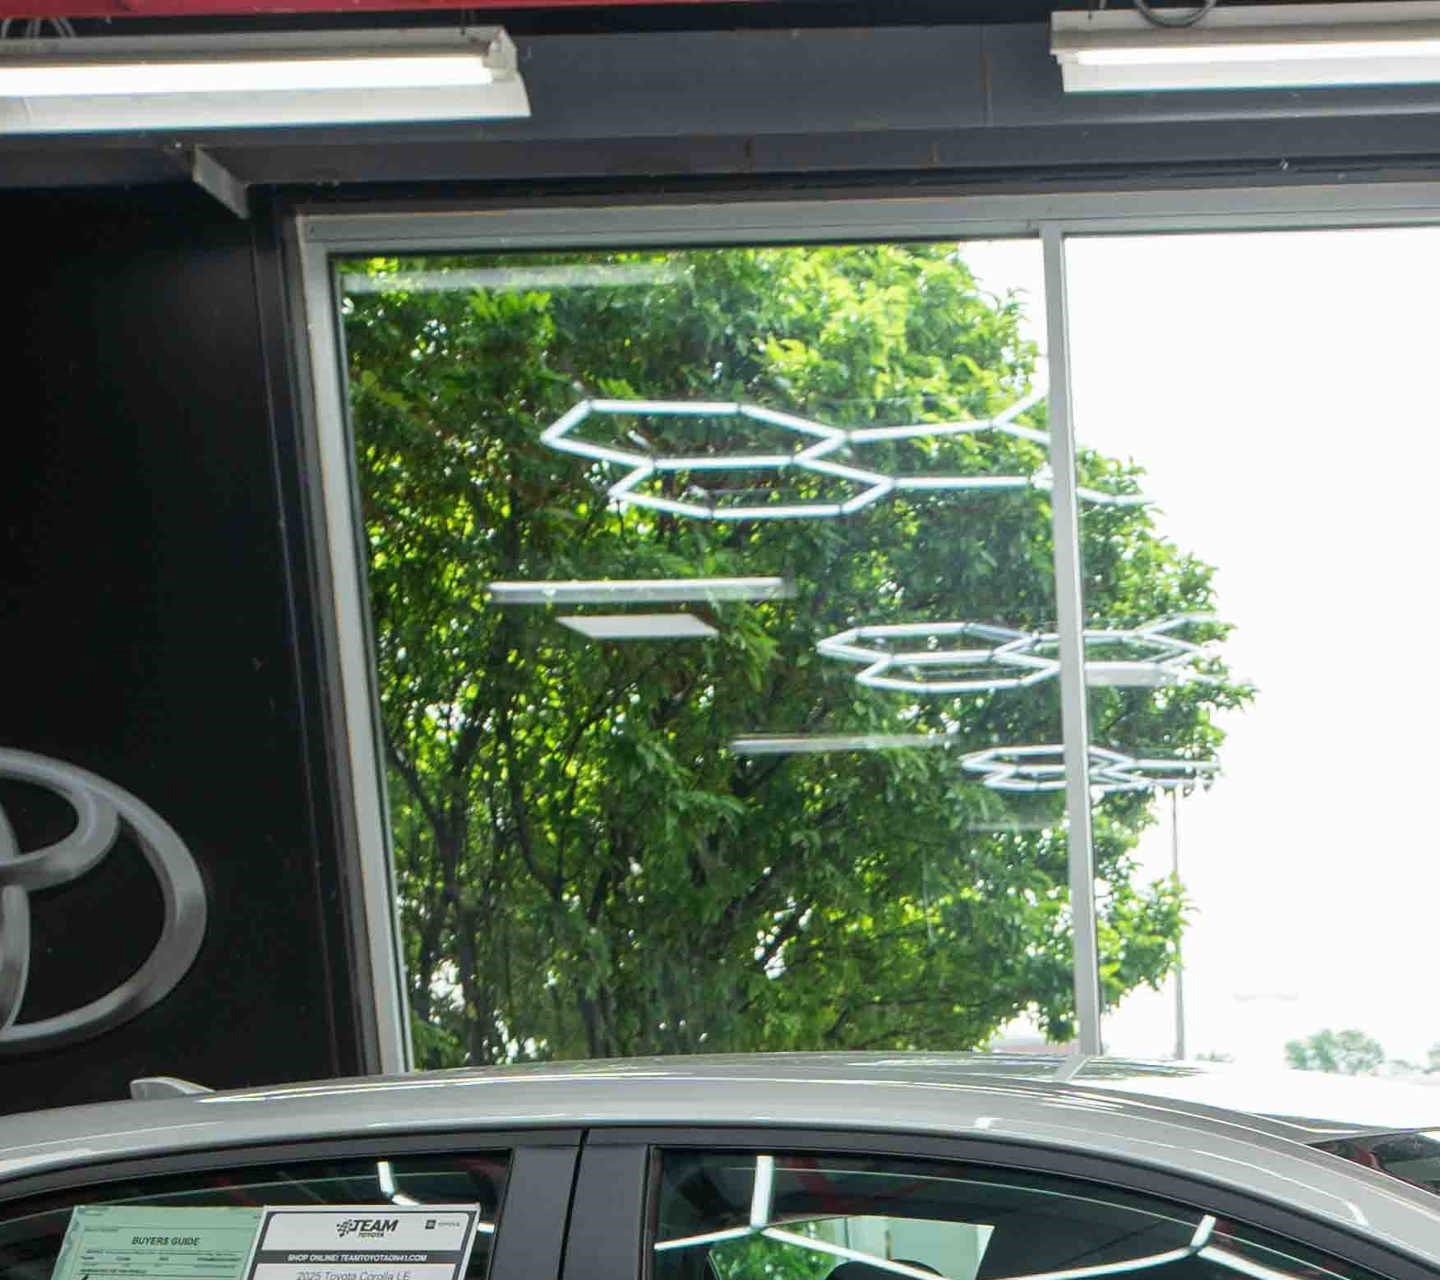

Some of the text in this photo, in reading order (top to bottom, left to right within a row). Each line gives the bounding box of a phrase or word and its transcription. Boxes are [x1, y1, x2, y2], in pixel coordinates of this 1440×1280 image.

[351, 1219, 399, 1232] TEAM
[131, 1236, 200, 1246] BUYERS GUIDE
